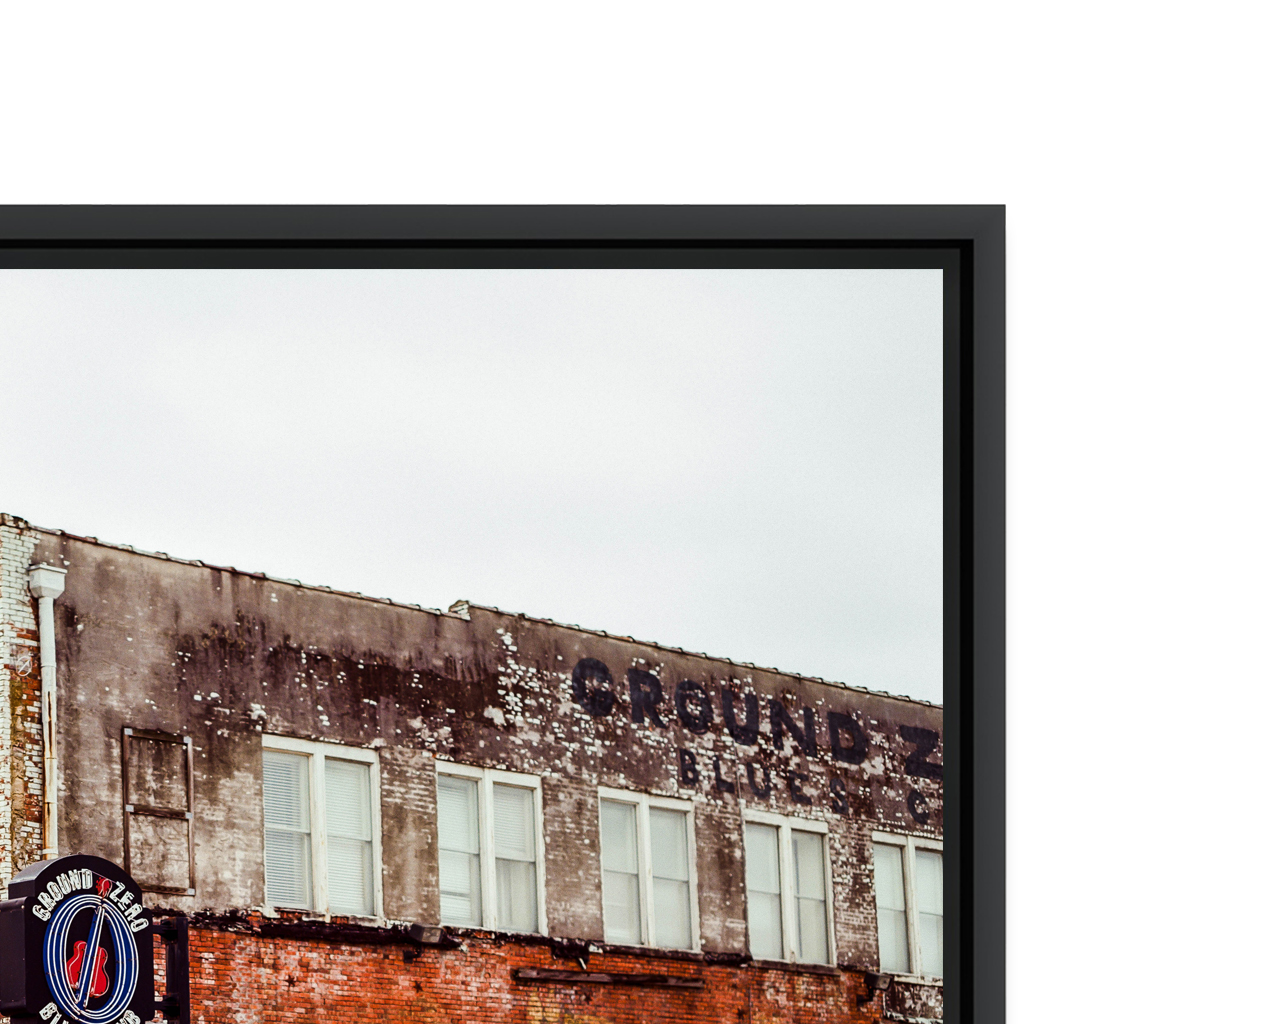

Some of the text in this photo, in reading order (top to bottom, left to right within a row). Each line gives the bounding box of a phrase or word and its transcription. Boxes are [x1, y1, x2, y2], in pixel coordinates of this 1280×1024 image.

[572, 657, 868, 765] GROUND
[679, 747, 850, 815] BLUES
[32, 868, 150, 933] GROUND ZERO
